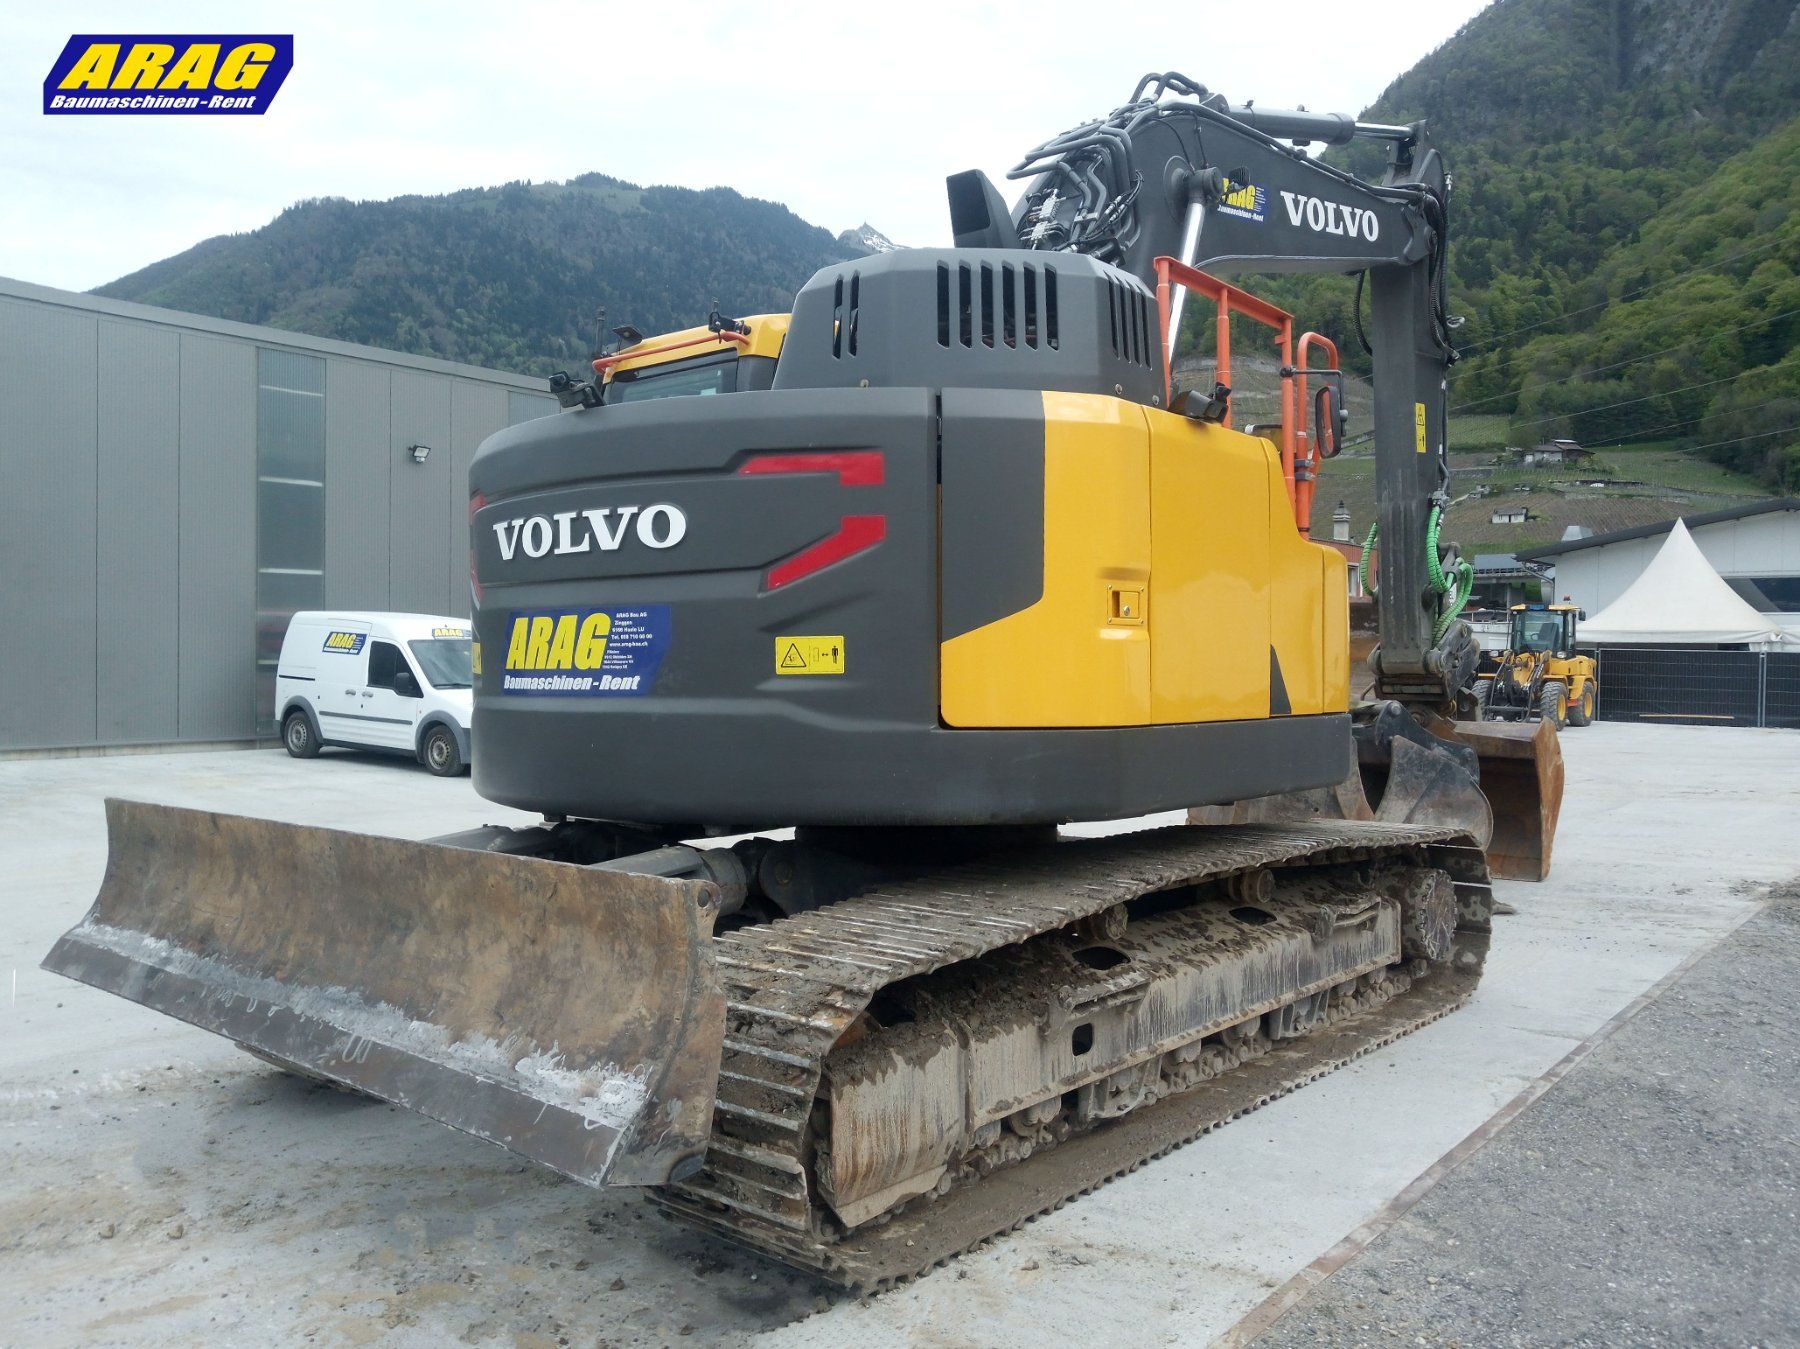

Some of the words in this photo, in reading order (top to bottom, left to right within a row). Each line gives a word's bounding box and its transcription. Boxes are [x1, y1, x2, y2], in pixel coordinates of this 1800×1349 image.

[1280, 190, 1379, 242] VOLVO
[492, 504, 687, 561] VOLVO
[325, 632, 357, 649] ARAG
[505, 612, 612, 670] ARAG
